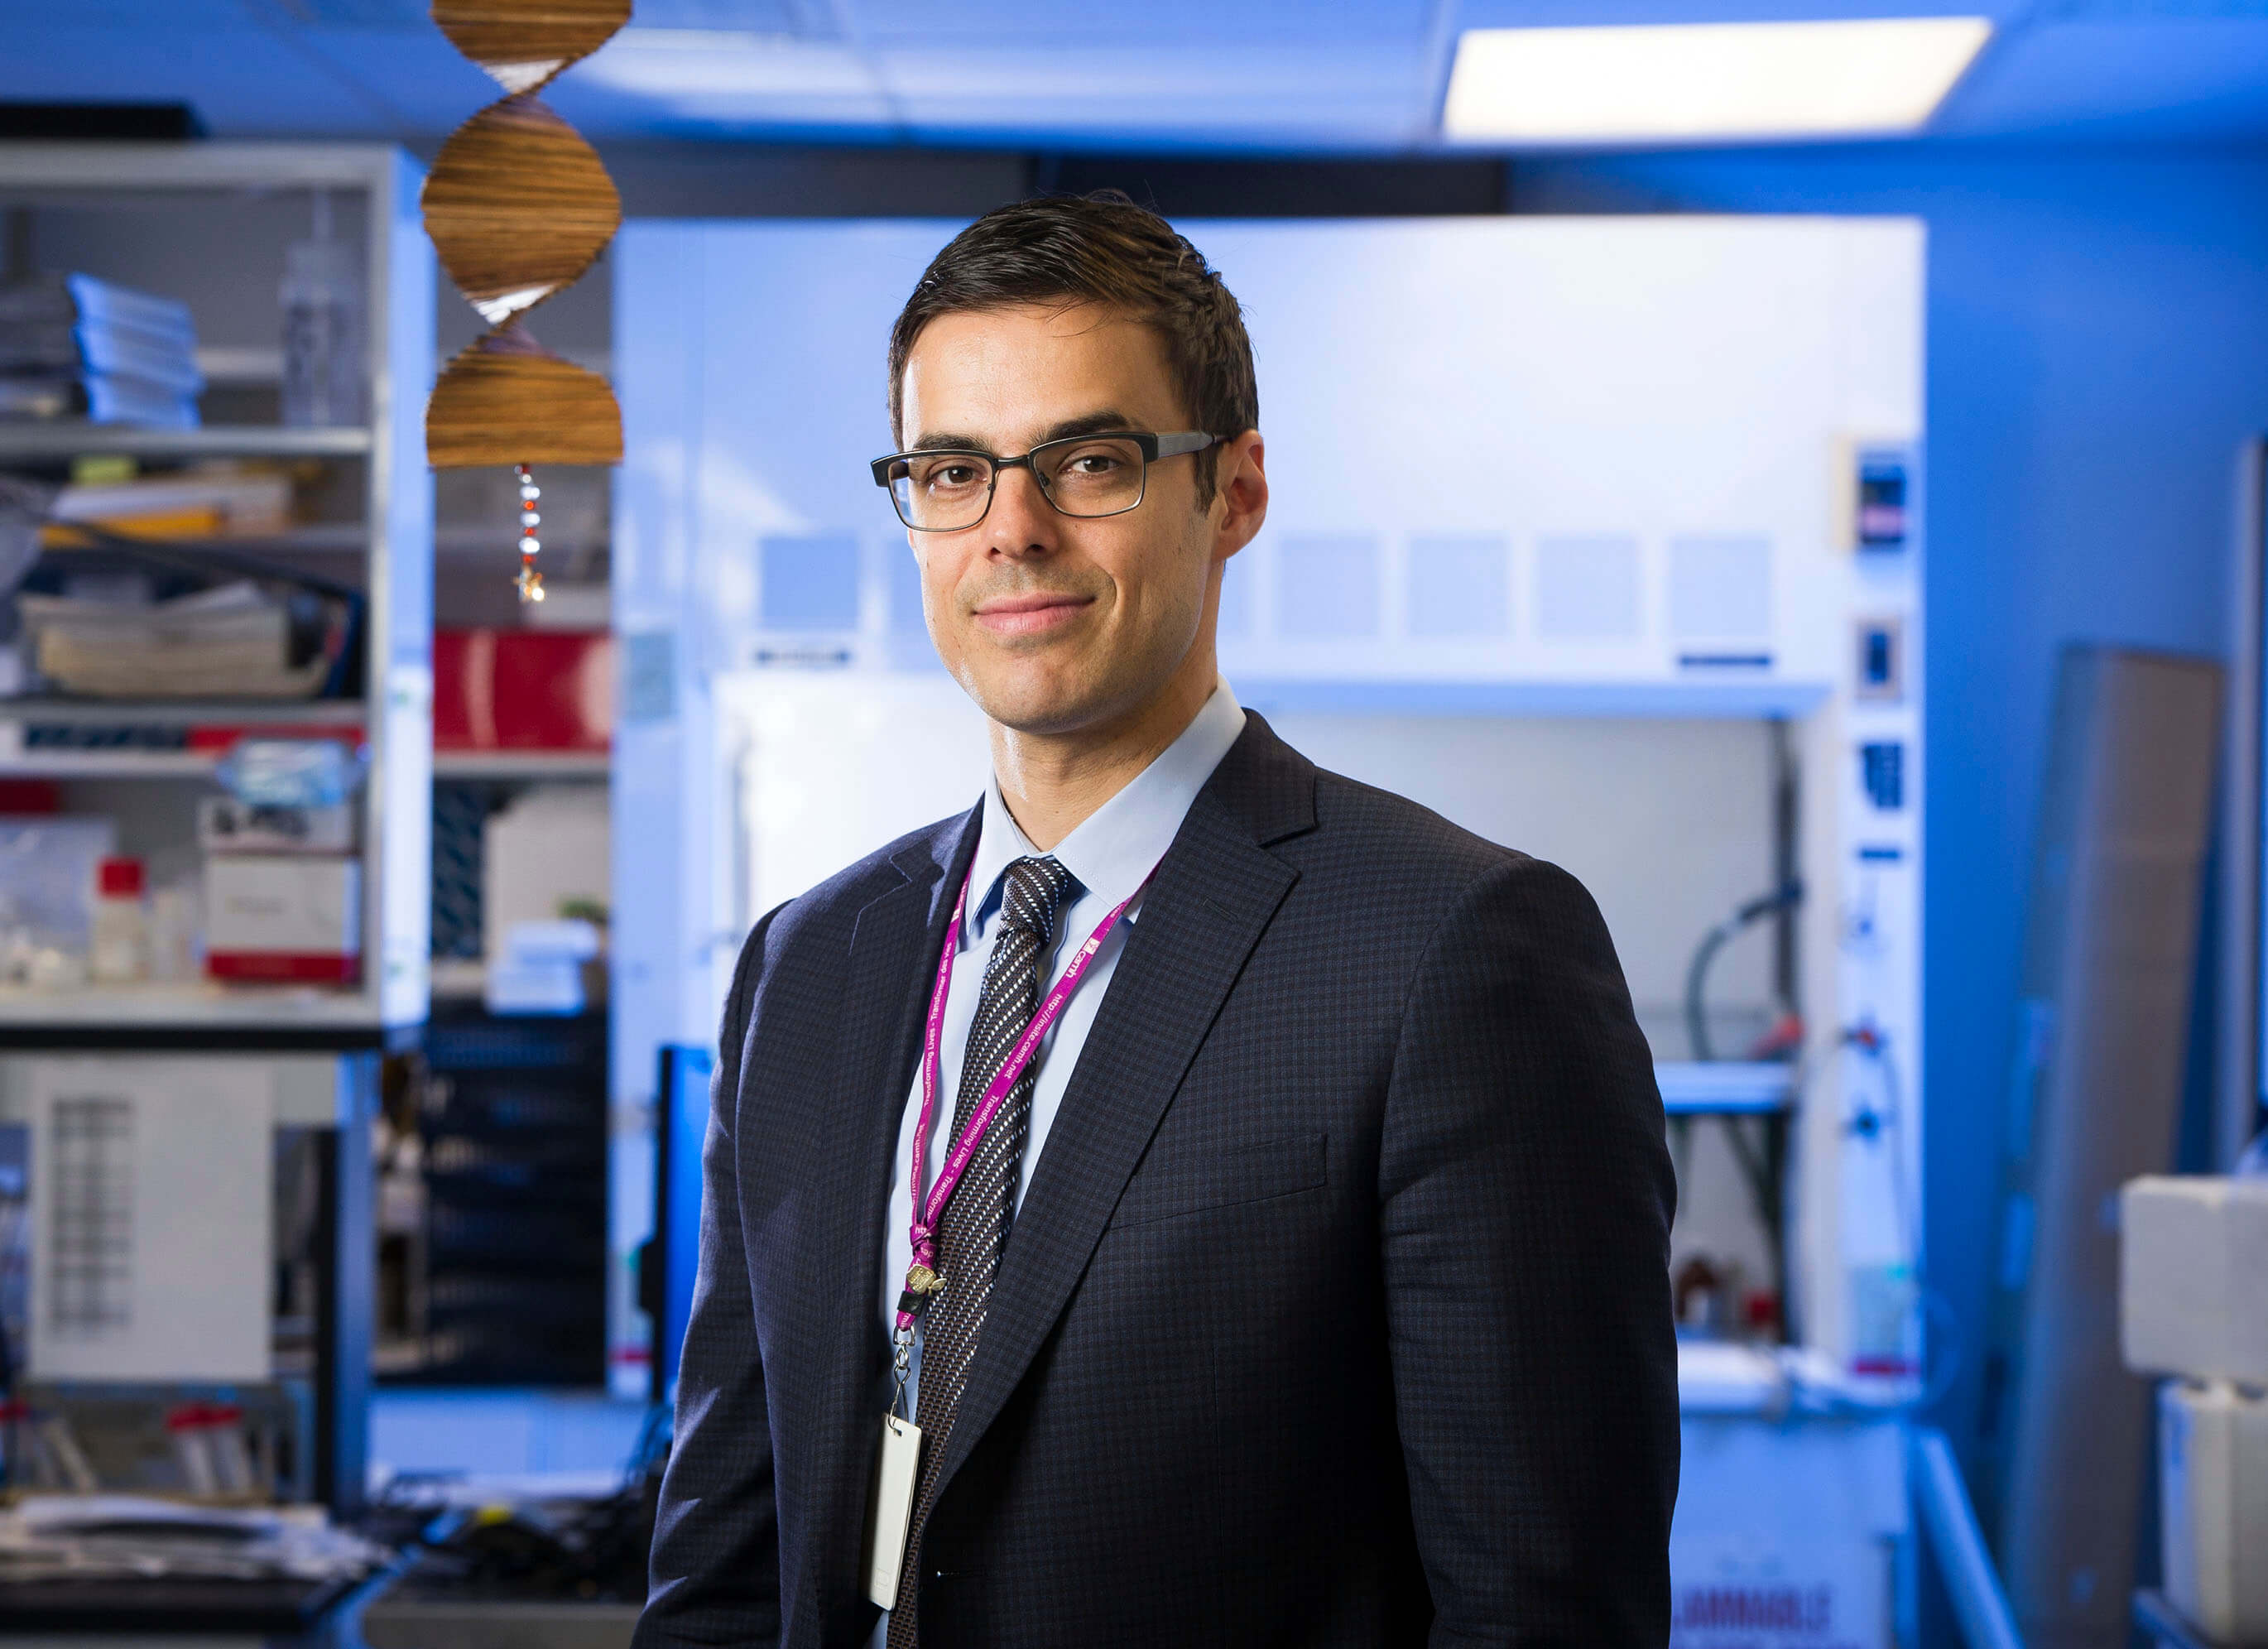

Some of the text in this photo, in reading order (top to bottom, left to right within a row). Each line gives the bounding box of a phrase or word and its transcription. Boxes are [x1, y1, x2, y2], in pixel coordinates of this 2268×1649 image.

[1065, 950, 1087, 979] camh
[930, 976, 946, 1021] Transformer
[927, 1029, 936, 1050] Lives
[1004, 993, 1063, 1079] http://insite.camh.net
[925, 1051, 935, 1107] Transforming
[964, 1094, 999, 1146] Transforming
[953, 1147, 969, 1168] Lives
[927, 1175, 954, 1219] Transforme
